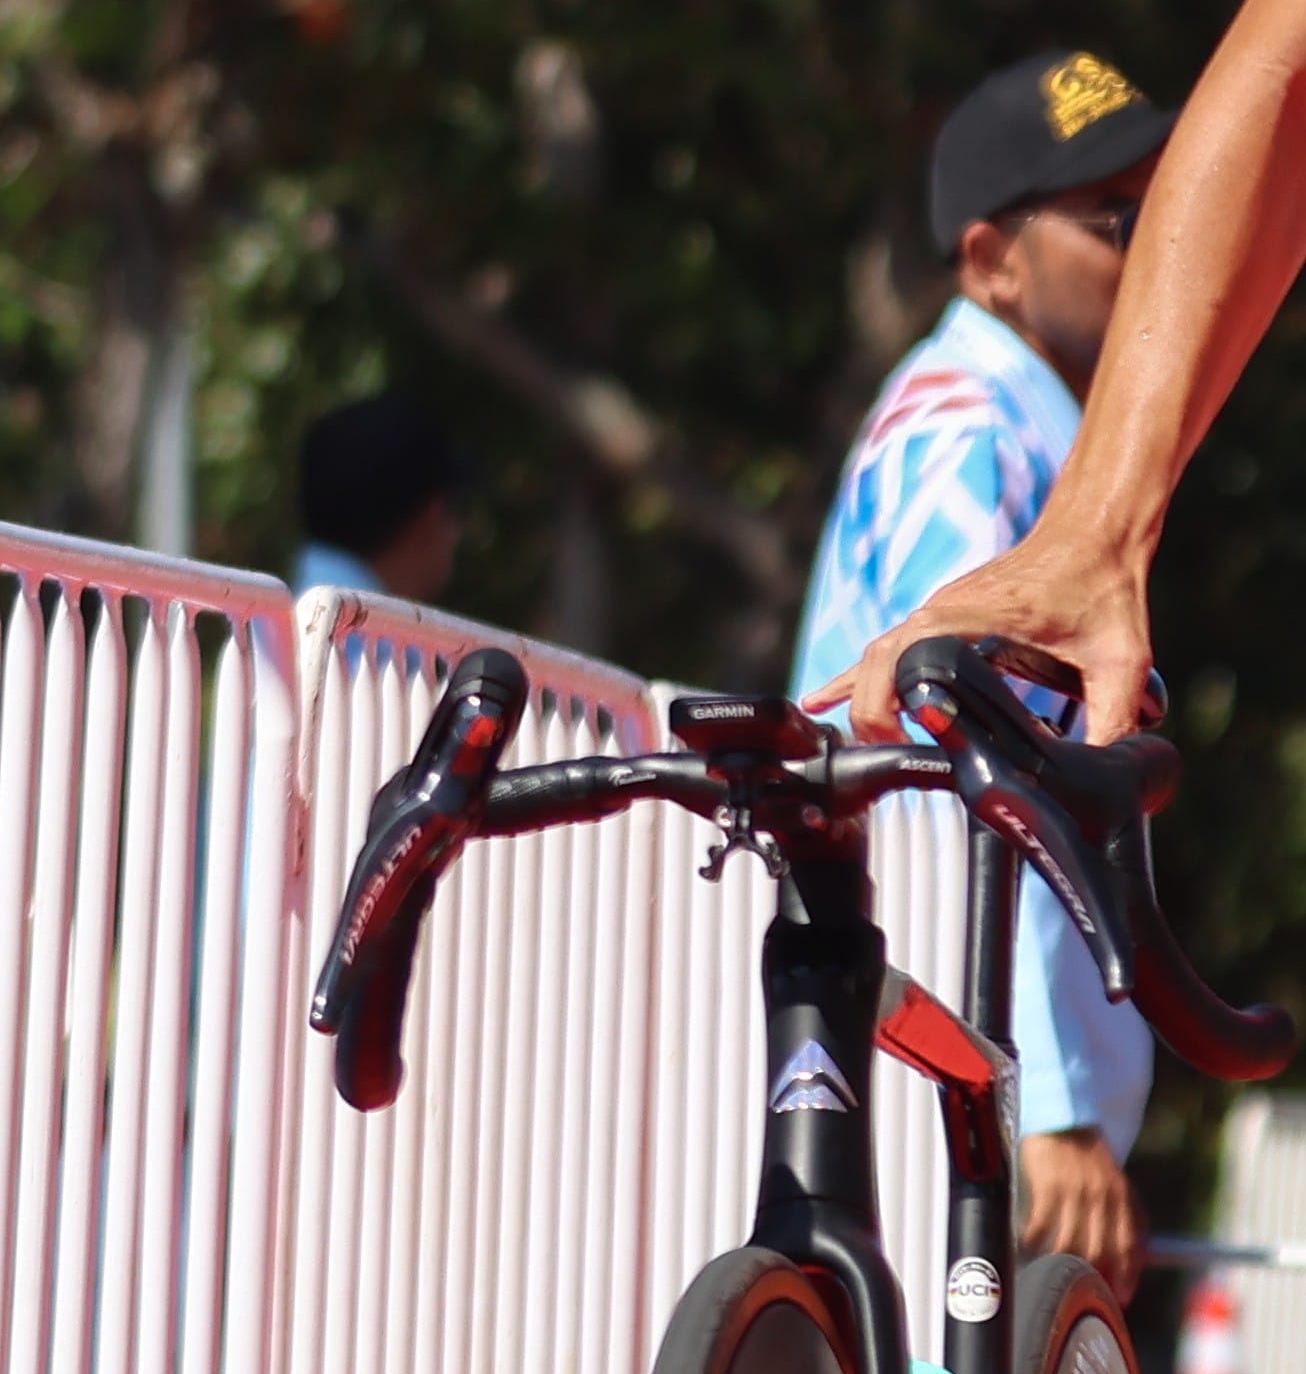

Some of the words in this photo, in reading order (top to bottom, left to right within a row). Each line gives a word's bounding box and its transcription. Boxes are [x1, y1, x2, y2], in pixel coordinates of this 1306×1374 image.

[692, 704, 755, 720] GARMIN
[991, 802, 1097, 934] ULTEGRA
[959, 1284, 991, 1296] UCI
